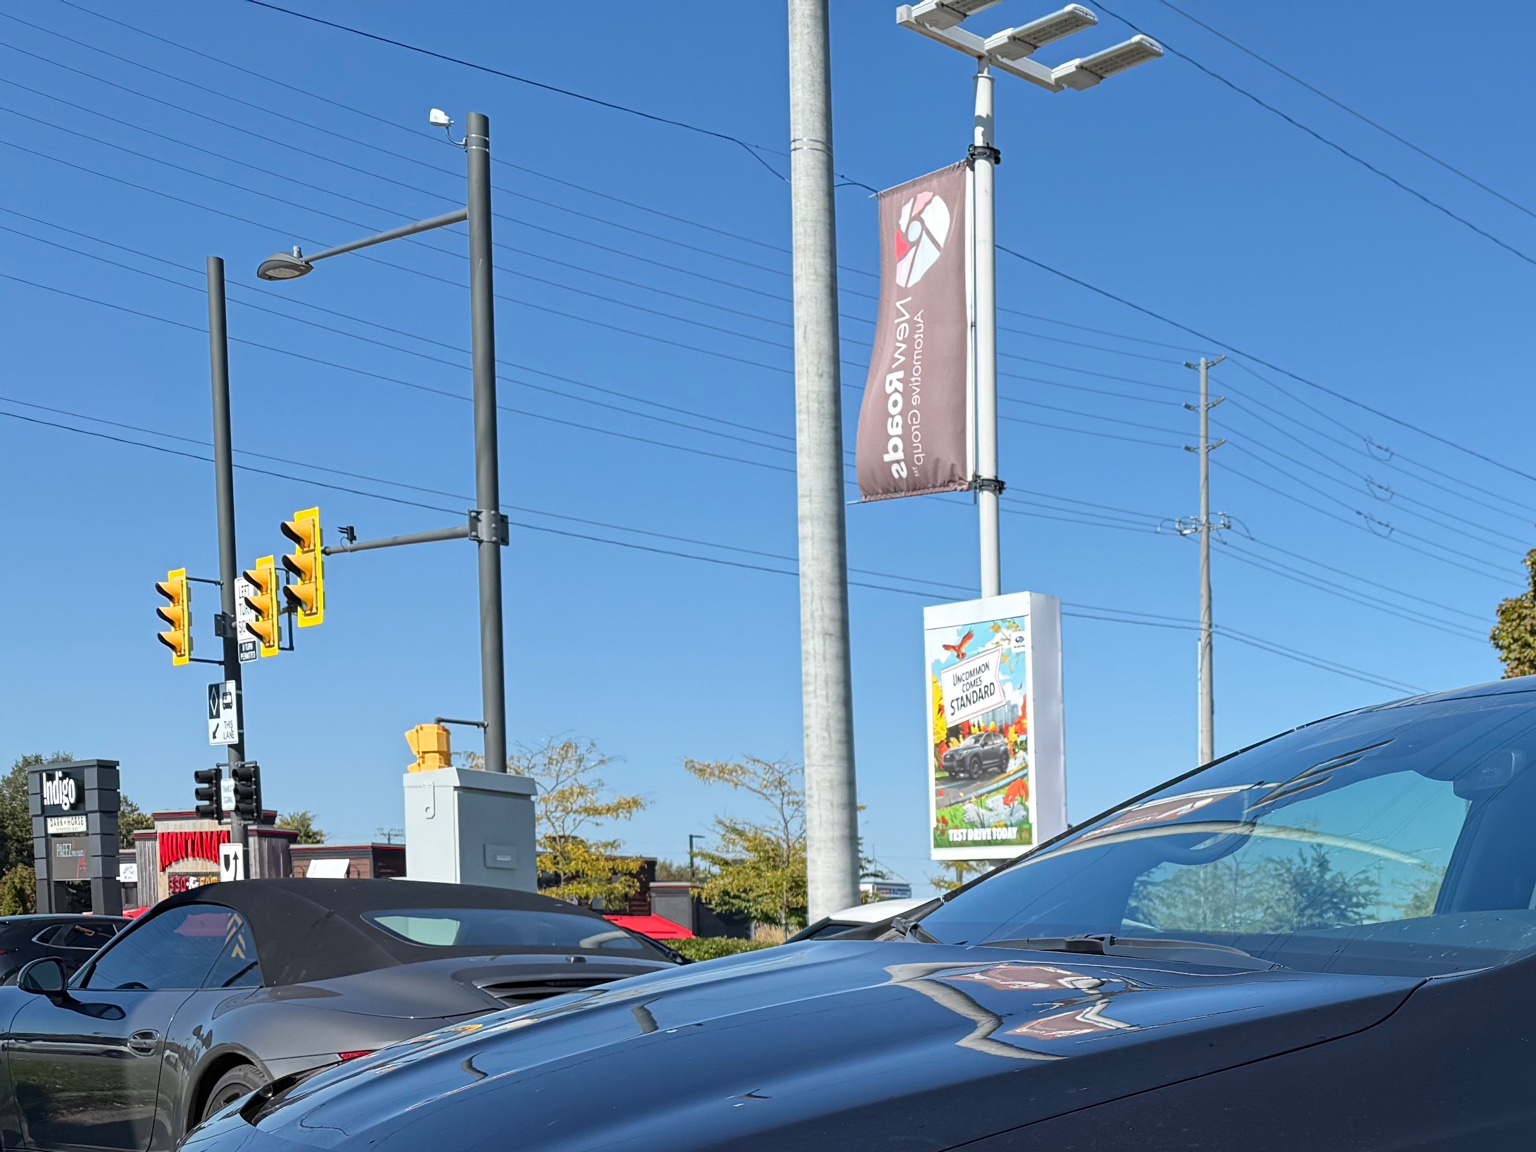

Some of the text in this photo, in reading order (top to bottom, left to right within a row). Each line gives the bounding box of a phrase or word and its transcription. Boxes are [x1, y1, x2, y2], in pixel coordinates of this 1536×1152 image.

[962, 676, 983, 693] COMES
[950, 682, 996, 716] STANDARD
[223, 730, 235, 740] LANE
[948, 827, 1018, 842] TEST DRIVE TODAY
